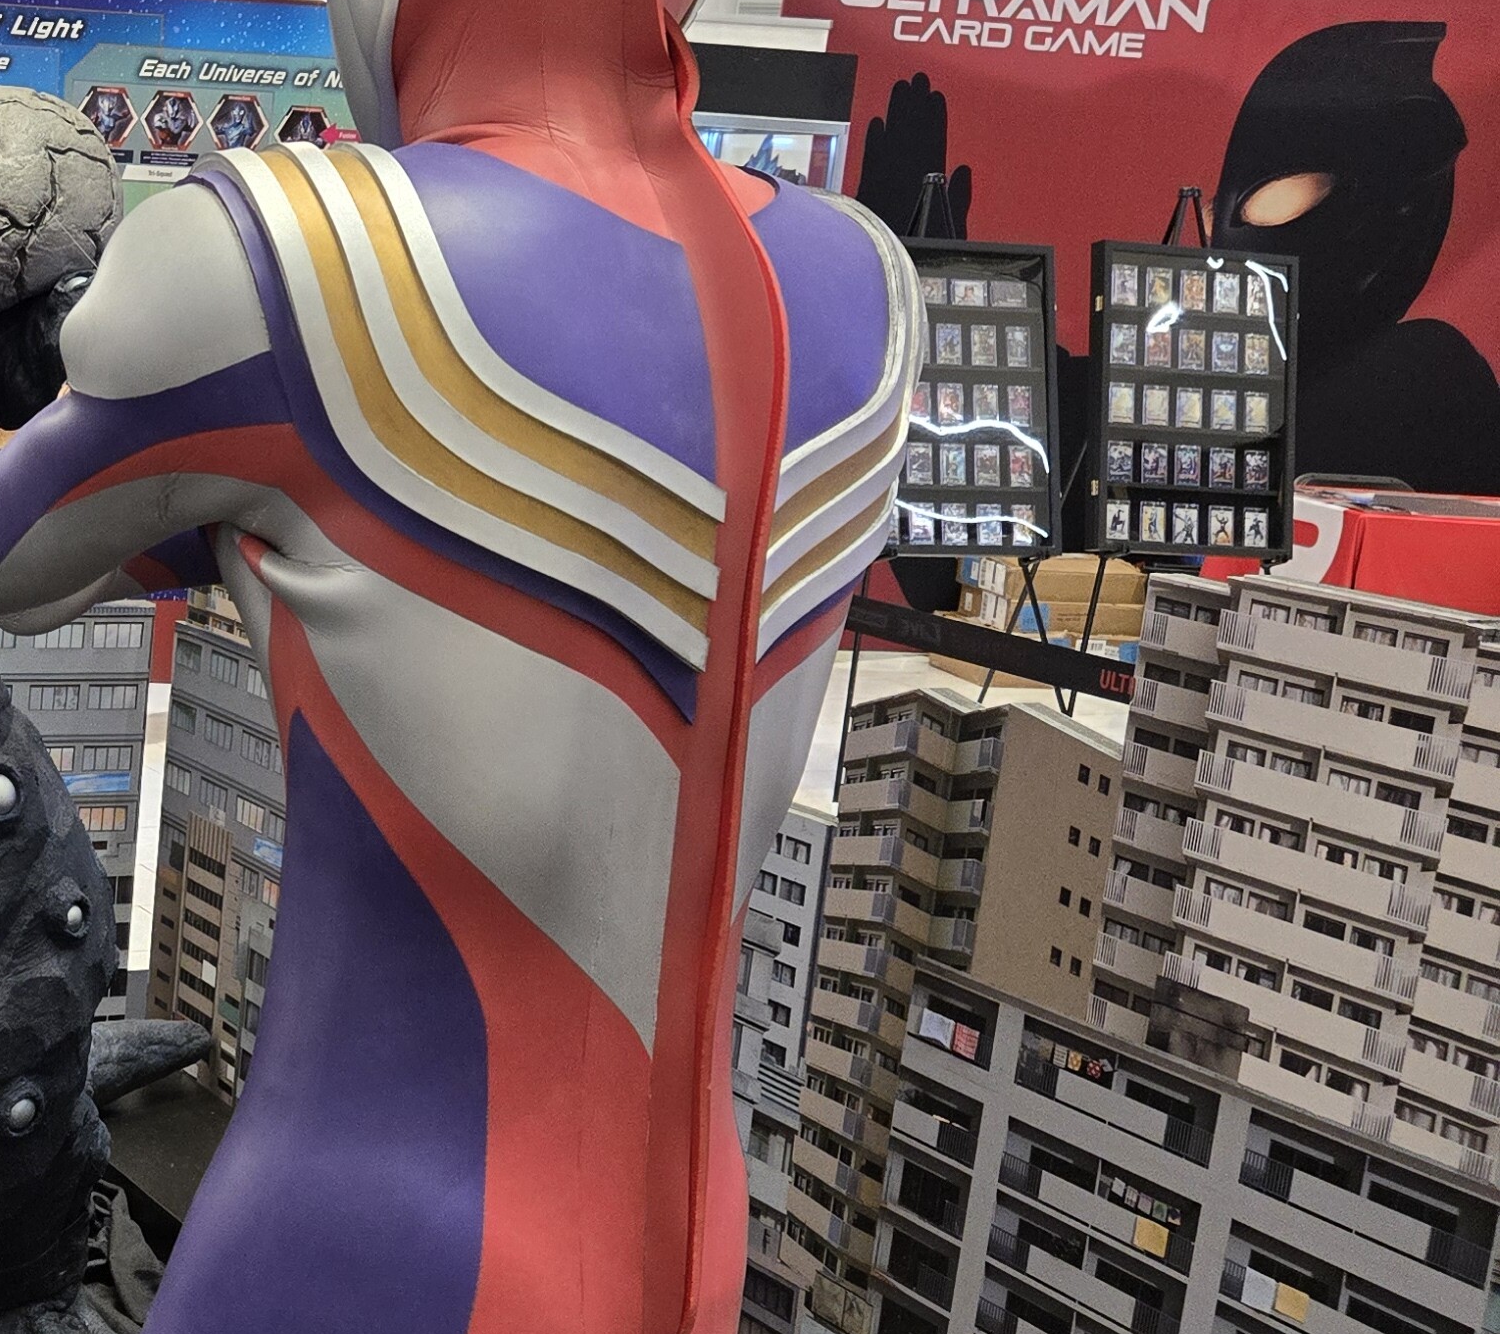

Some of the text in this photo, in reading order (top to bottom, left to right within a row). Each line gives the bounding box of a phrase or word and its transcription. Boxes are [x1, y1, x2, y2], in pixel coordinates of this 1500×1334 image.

[11, 15, 84, 40] Light
[893, 14, 1144, 59] CARD GAME
[139, 59, 192, 80] Each
[199, 63, 287, 86] Universe
[294, 69, 322, 87] of
